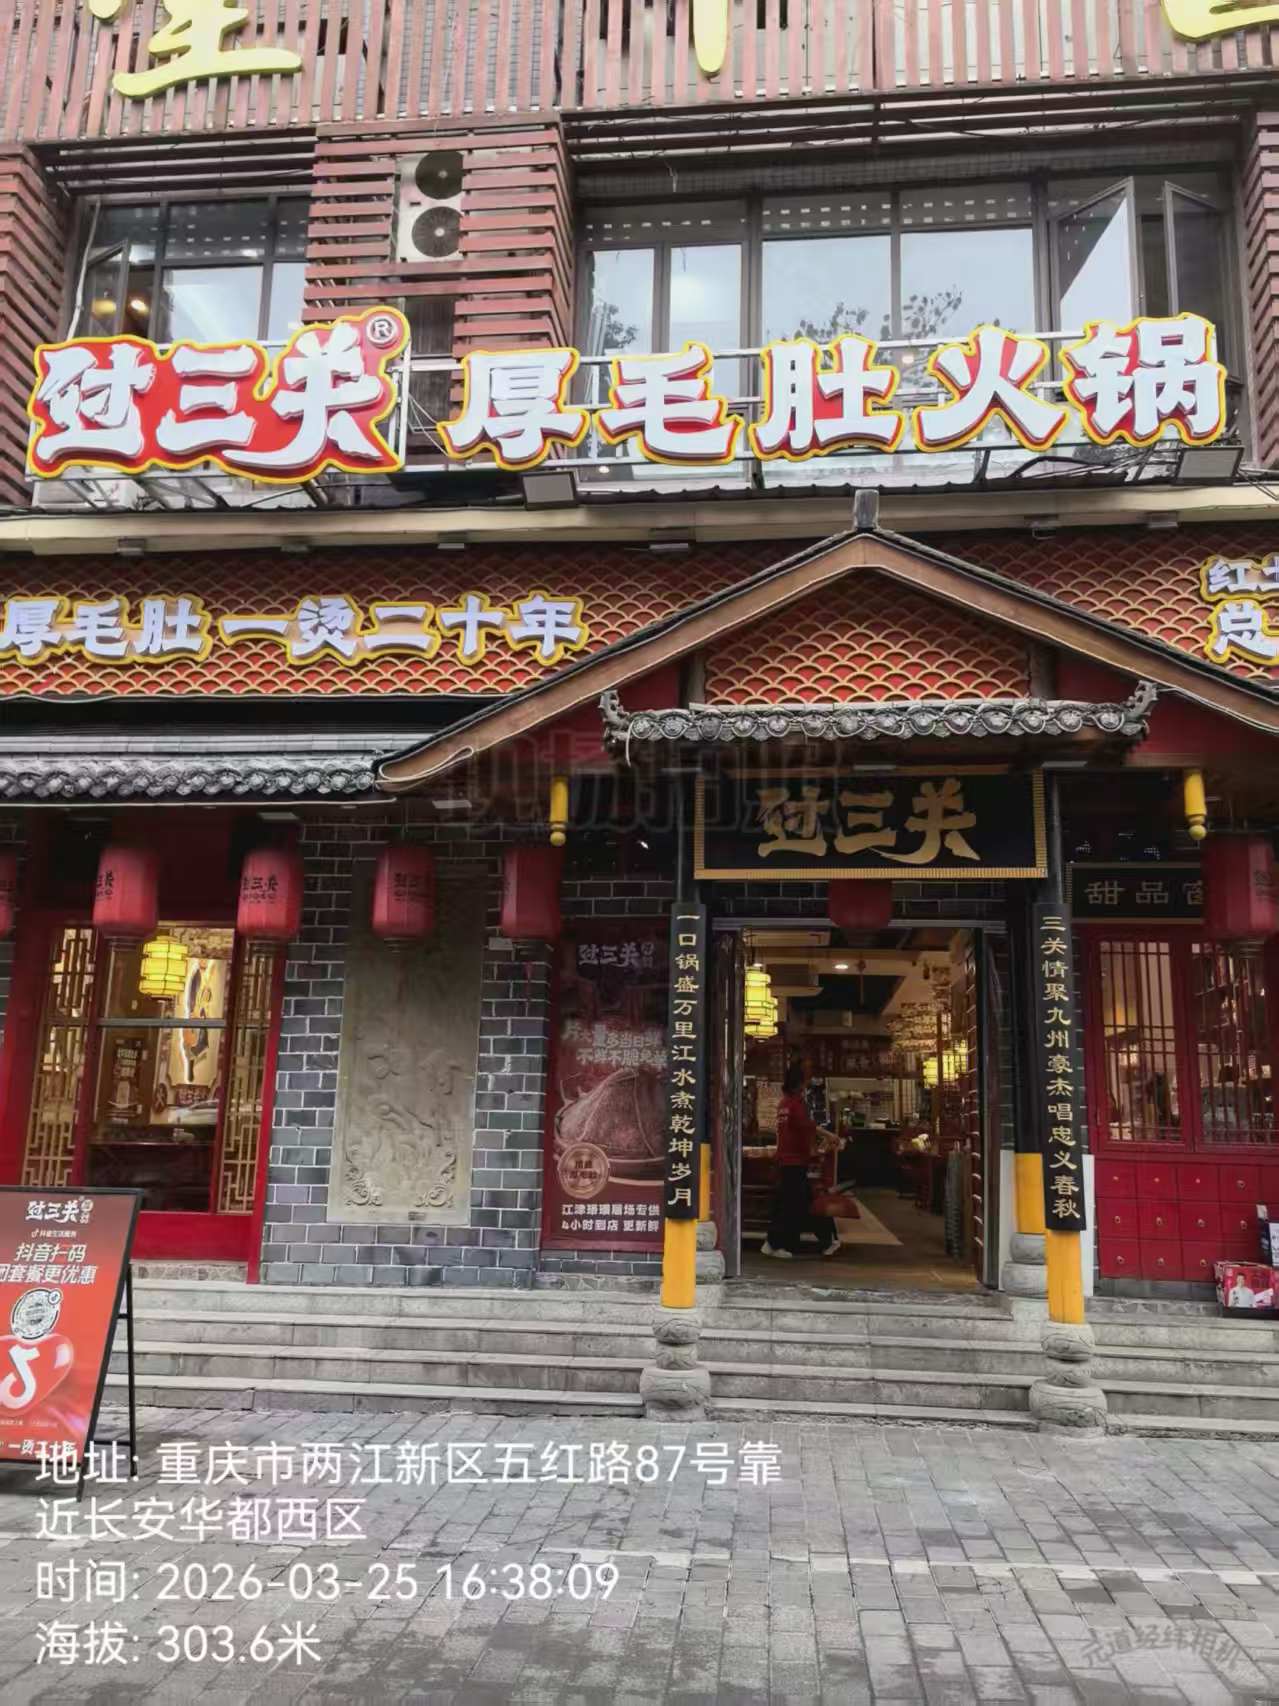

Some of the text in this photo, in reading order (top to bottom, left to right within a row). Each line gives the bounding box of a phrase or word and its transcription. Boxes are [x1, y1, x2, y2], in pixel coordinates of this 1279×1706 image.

[444, 316, 1220, 461] 厚毛肚火锅
[1, 594, 582, 658] 厚毛肚一烫二十年
[757, 779, 981, 864] 过三关
[668, 914, 699, 1206] 一口锅盛万里江水煮乾坤岁月
[1041, 916, 1080, 1220] 三关情聚九州豪杰唱忠义春秋
[14, 1243, 87, 1262] 抖音扫码
